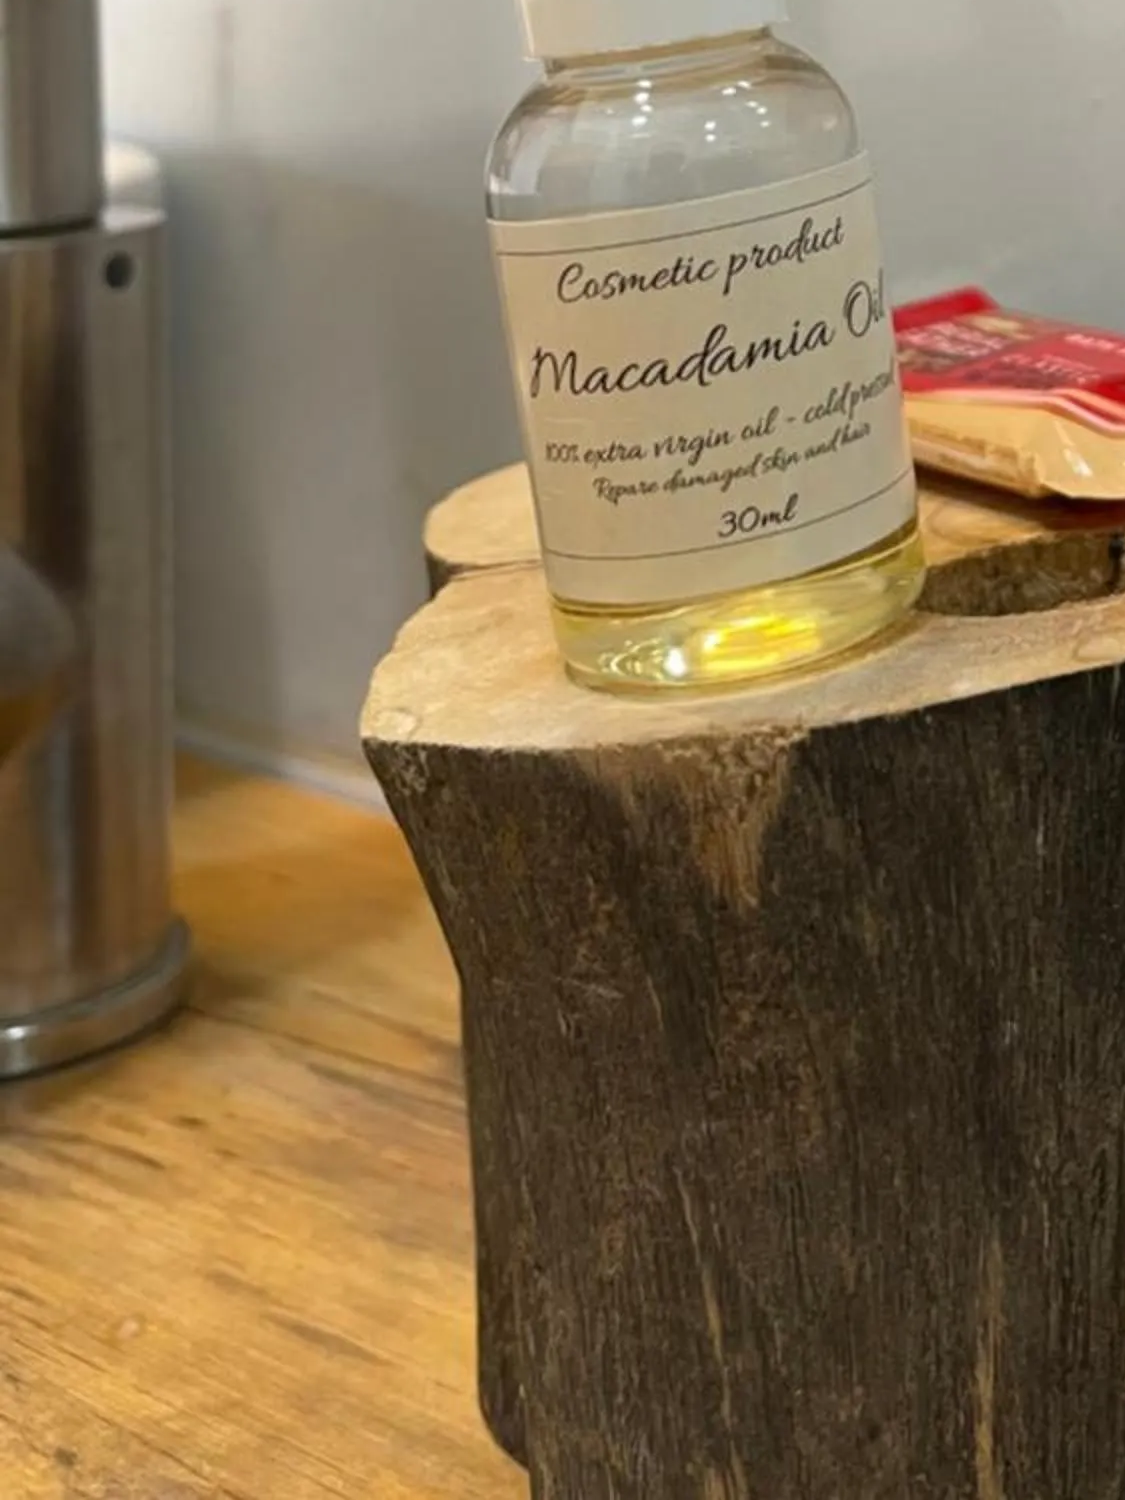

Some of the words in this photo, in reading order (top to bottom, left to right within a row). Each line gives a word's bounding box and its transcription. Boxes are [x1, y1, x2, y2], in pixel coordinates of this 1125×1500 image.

[557, 257, 719, 303] Cosmetic
[723, 216, 845, 295] product
[530, 324, 836, 398] Macadamia
[843, 267, 884, 337] Oil
[584, 438, 647, 469] extra
[653, 428, 733, 466] virgin
[741, 406, 780, 441] oil
[804, 379, 850, 423] cold
[663, 453, 758, 493] damaged
[762, 446, 801, 472] skin
[804, 428, 843, 457] and
[718, 493, 799, 538] 30ml
